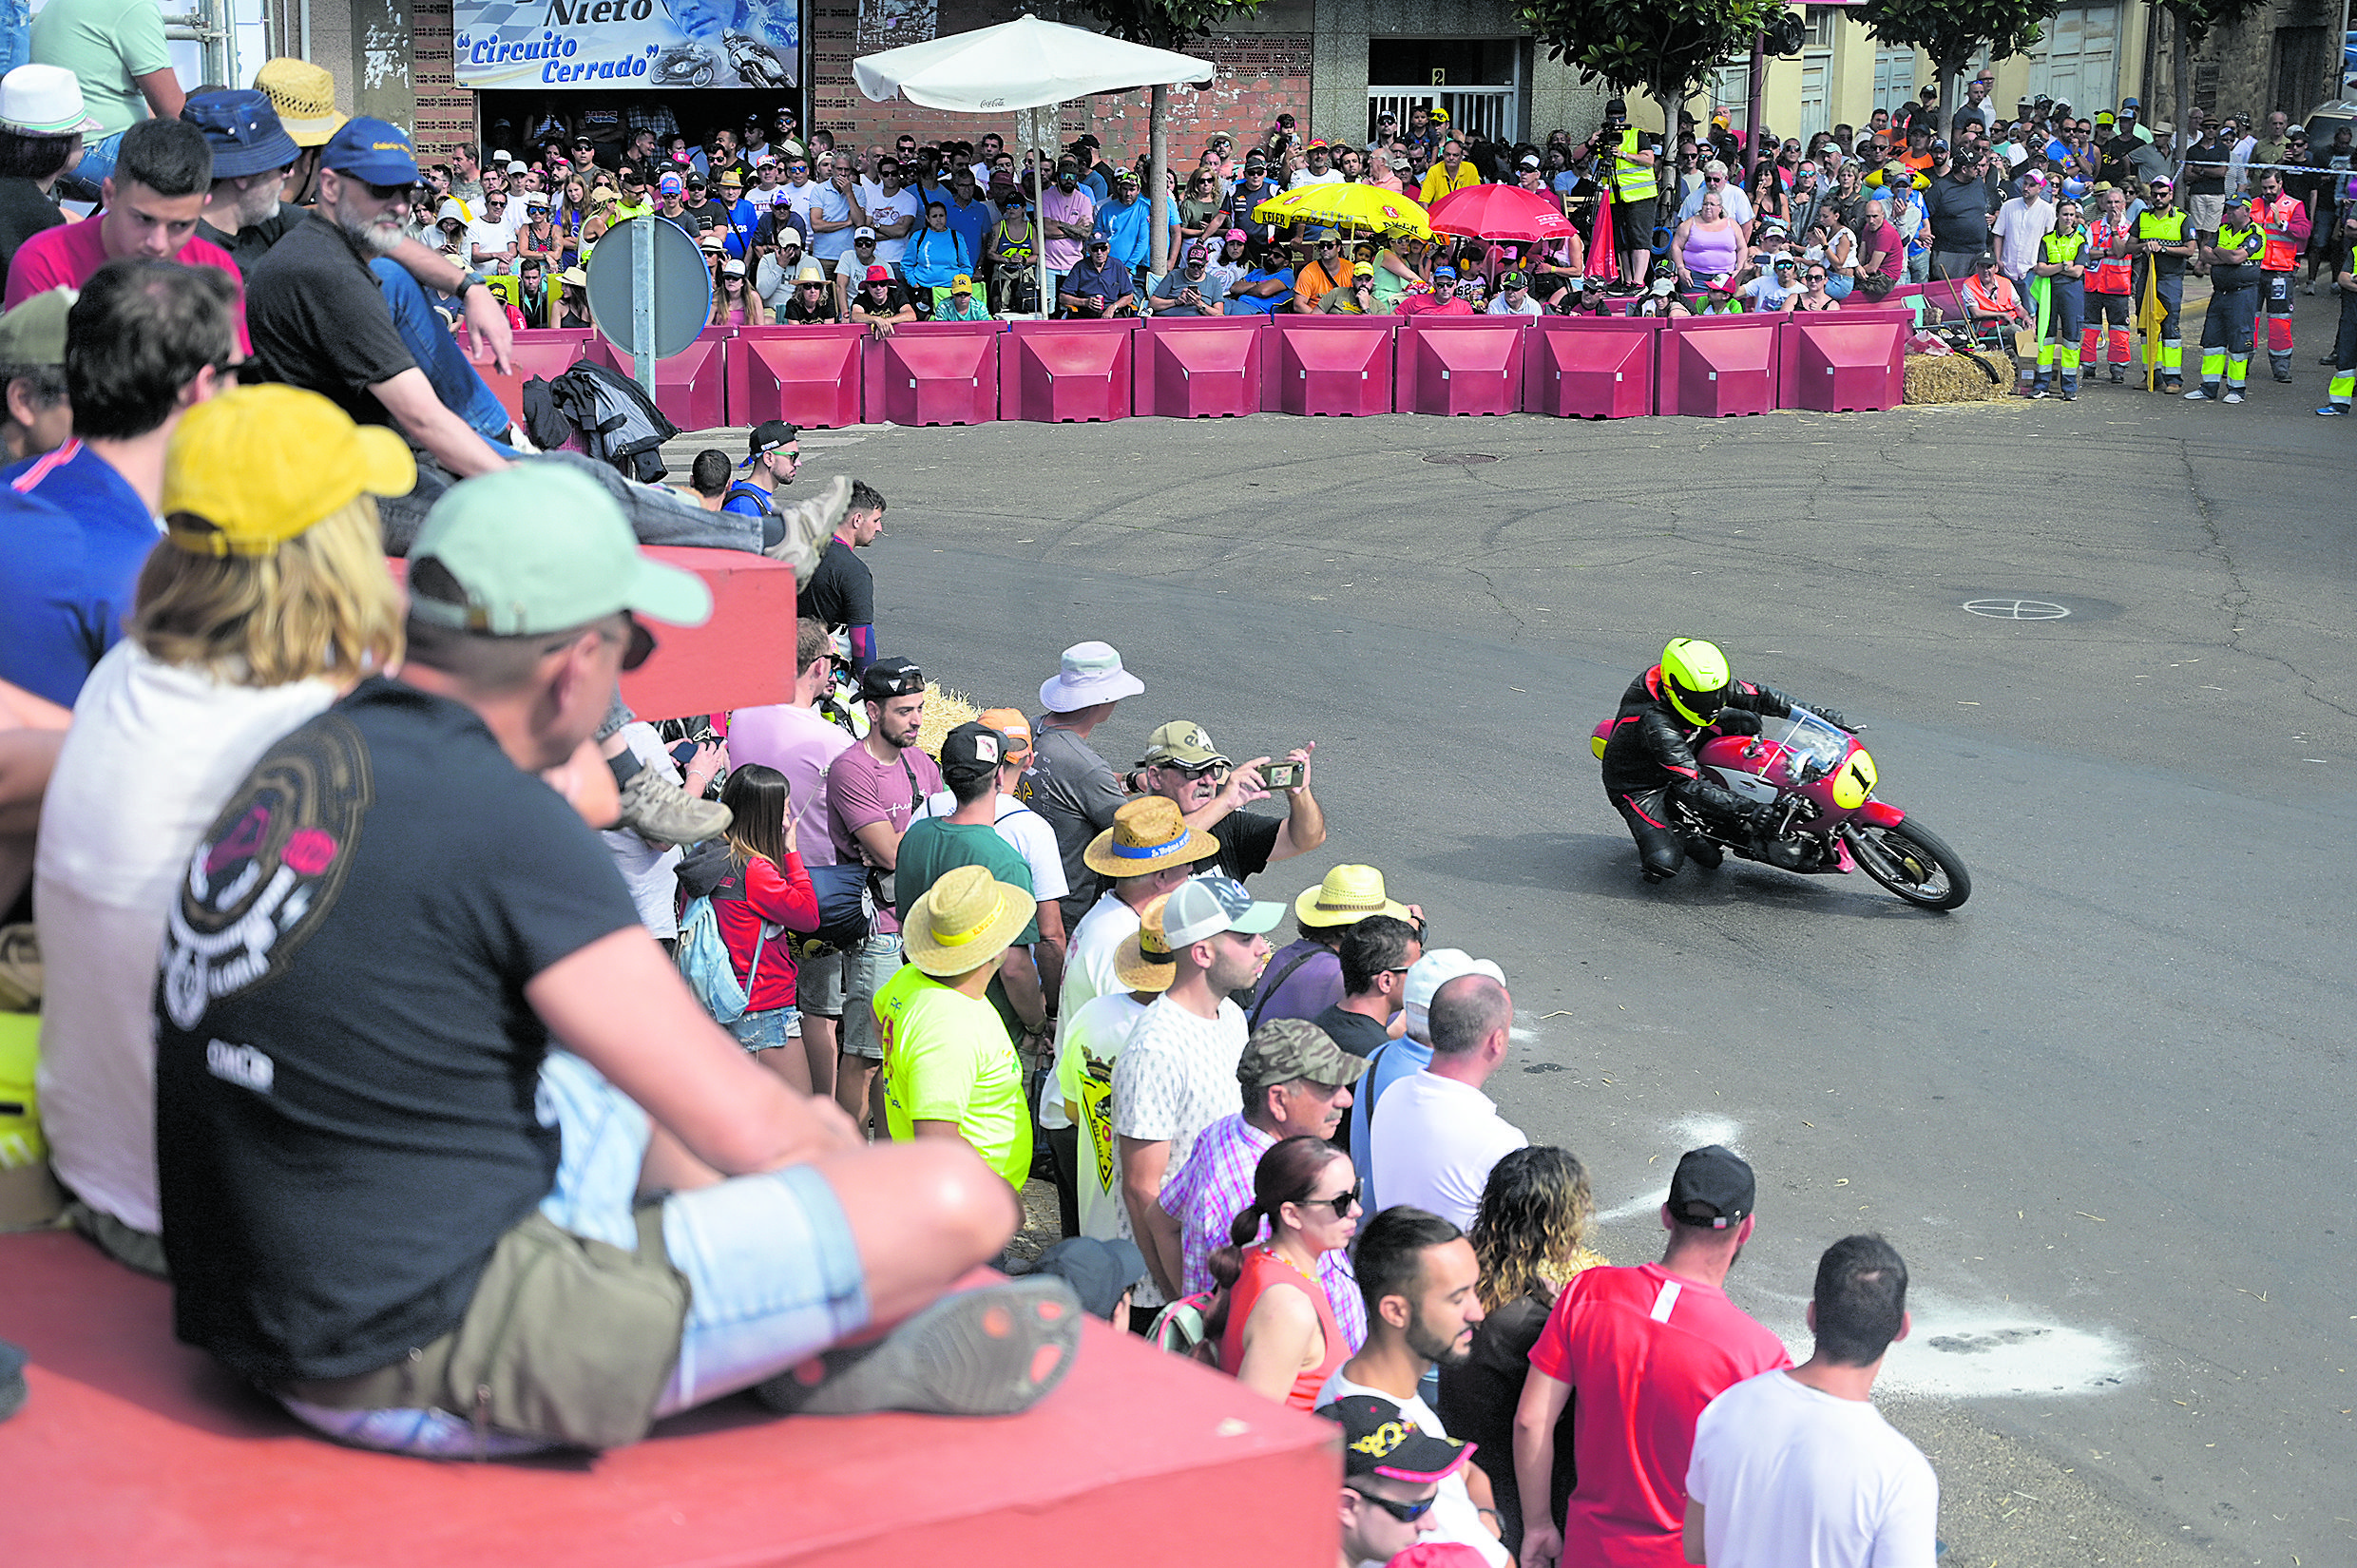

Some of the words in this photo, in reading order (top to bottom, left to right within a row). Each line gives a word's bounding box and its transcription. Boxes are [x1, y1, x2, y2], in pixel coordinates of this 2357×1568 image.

[544, 0, 653, 27] Nieto
[1434, 69, 1444, 86] 2
[1262, 211, 1286, 226] KELER
[1850, 762, 1870, 794] 1
